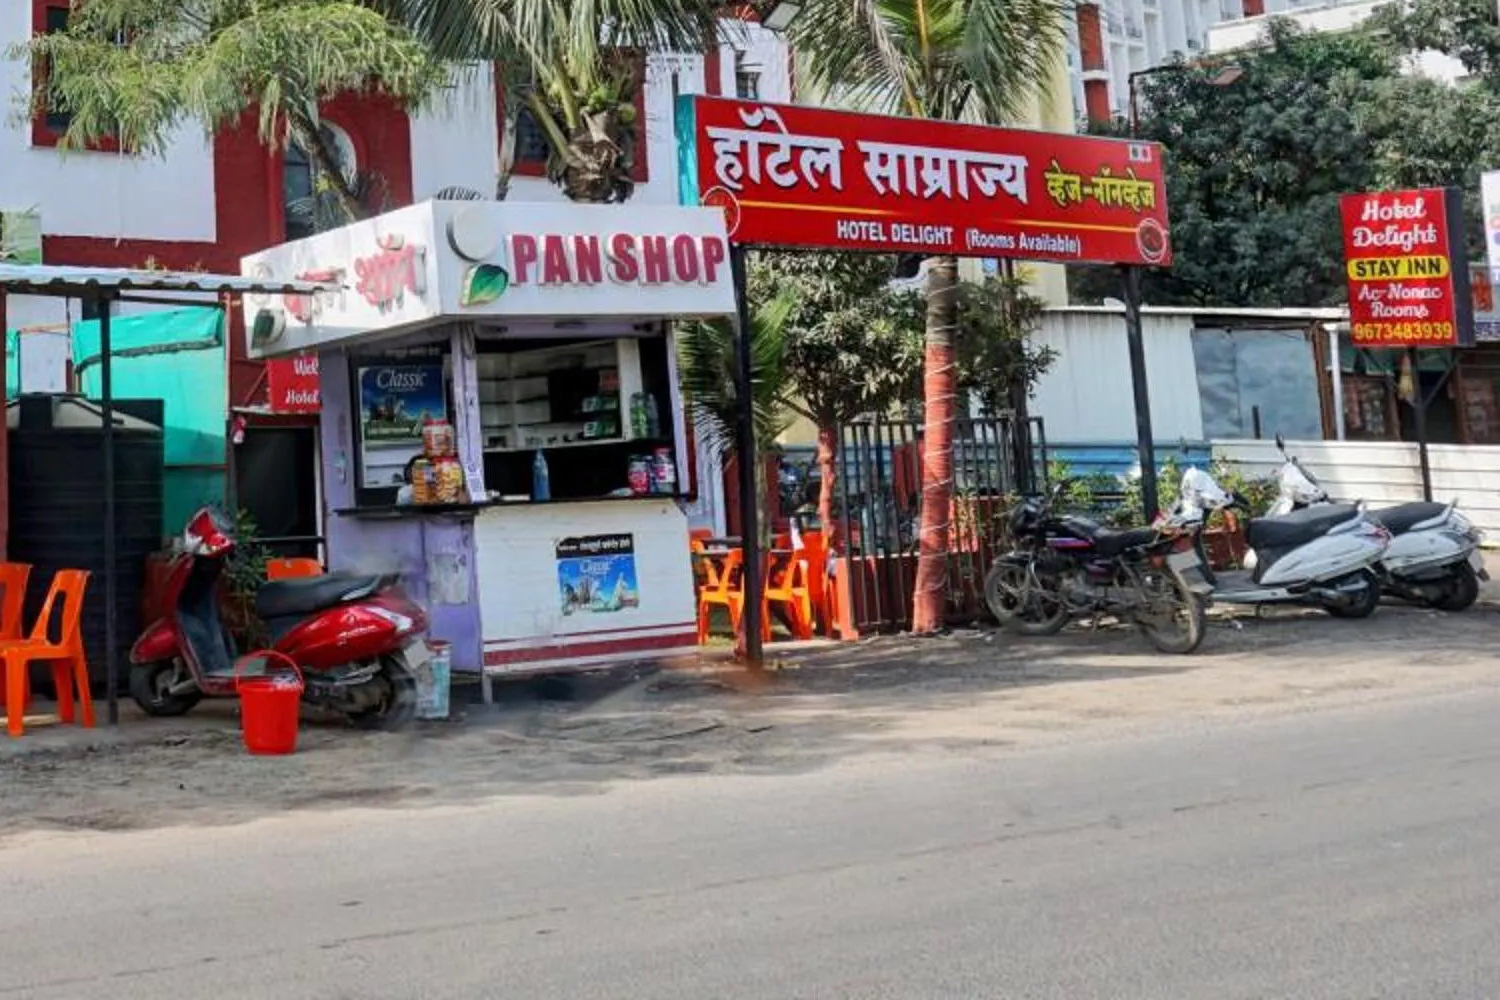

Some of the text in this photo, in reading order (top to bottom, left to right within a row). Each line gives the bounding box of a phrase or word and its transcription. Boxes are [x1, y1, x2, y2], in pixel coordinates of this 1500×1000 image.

[706, 106, 1029, 204] हॉटेल साम्राज्य
[1361, 197, 1427, 222] Hotel
[837, 220, 1081, 258] HOTEL DELIGHT (Rooms Available)
[1353, 223, 1438, 252] Delight
[506, 232, 725, 286] PAN SHOP
[1355, 257, 1442, 277] STAY INN
[1371, 300, 1430, 319] Rooms
[1354, 321, 1454, 341] 9673483939
[375, 367, 429, 390] Classic
[285, 388, 321, 406] Hotel
